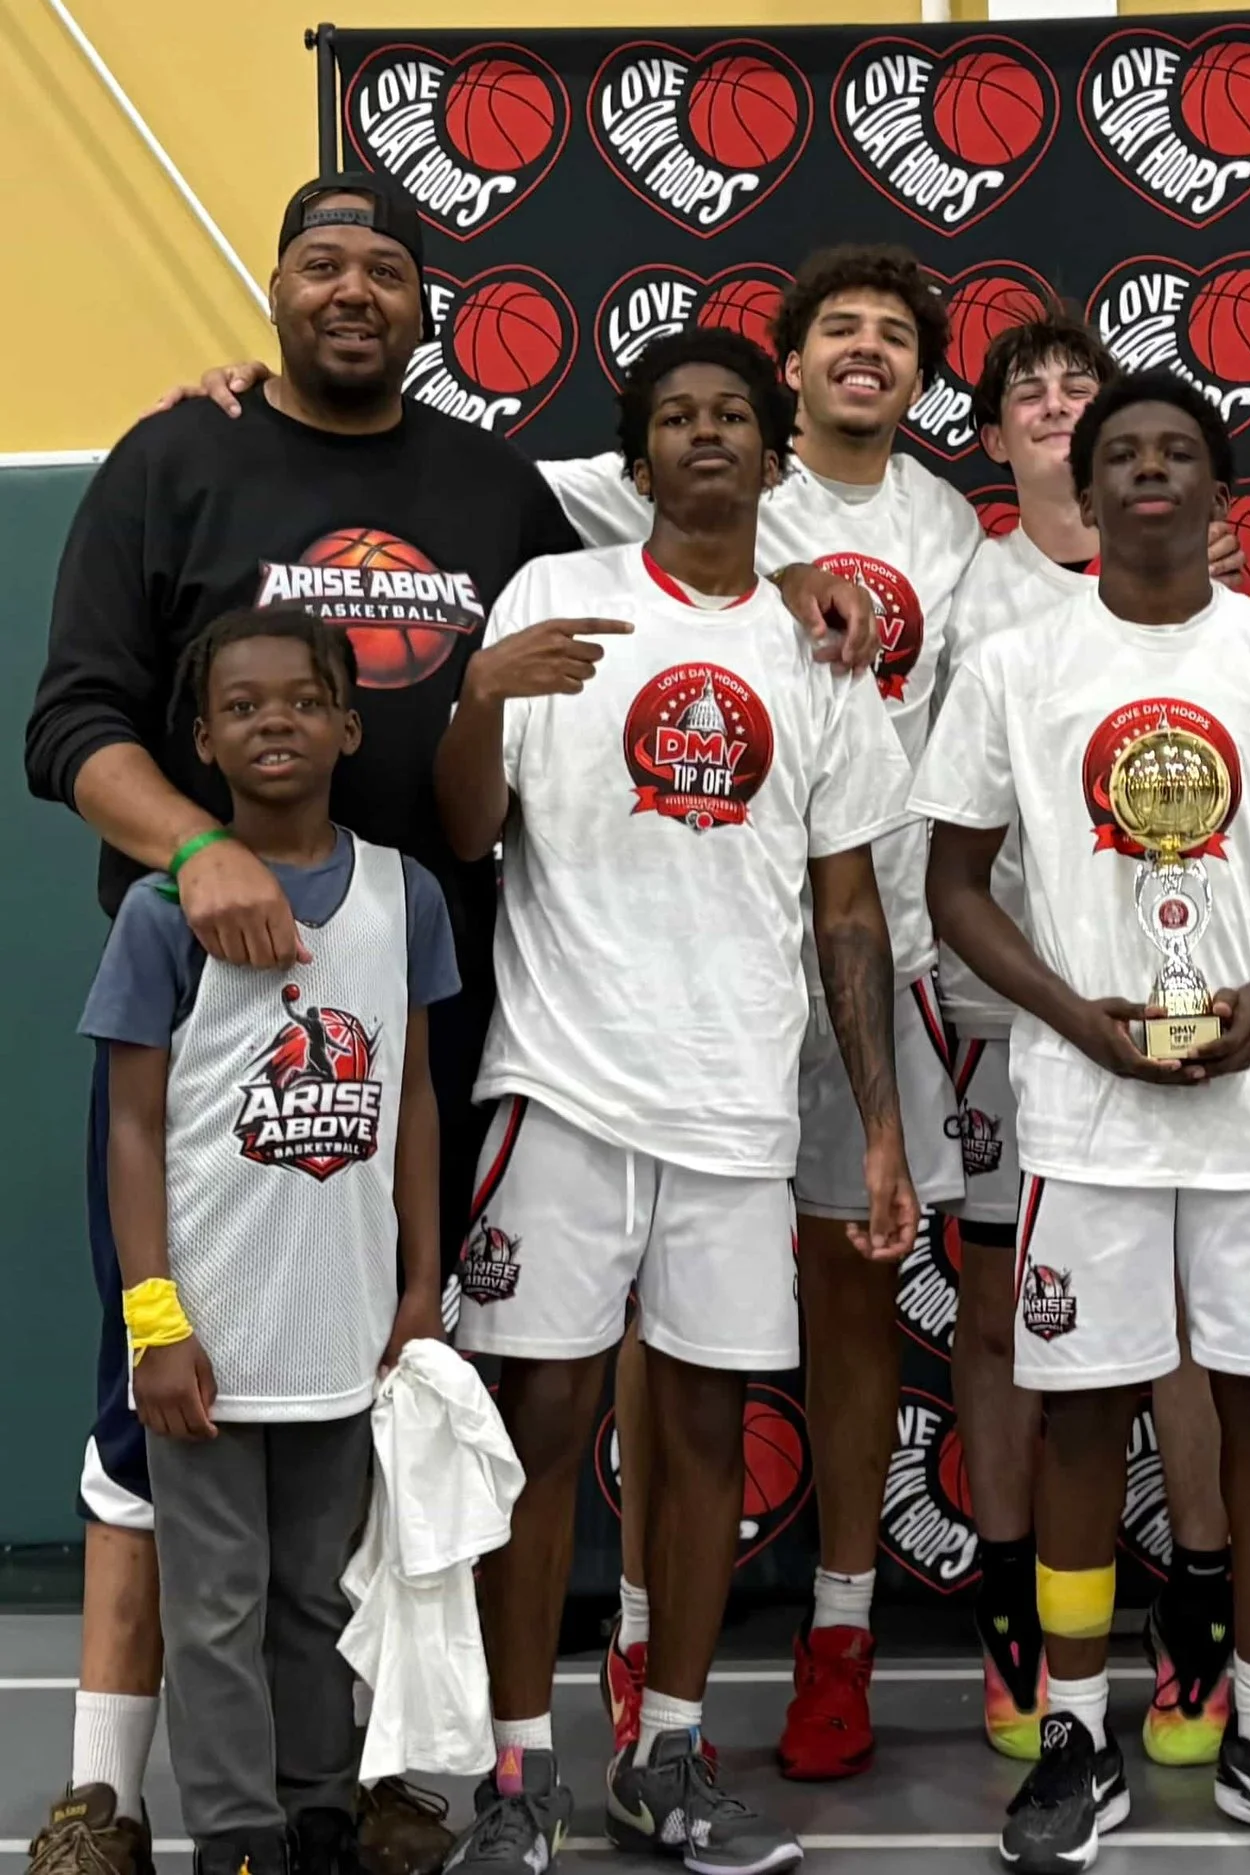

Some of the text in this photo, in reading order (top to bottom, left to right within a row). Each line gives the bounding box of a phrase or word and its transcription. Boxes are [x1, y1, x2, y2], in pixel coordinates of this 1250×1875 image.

[602, 59, 688, 131] LOVE
[1093, 47, 1180, 120] LOVE
[360, 62, 516, 227] LOVE DAY HOOPS
[609, 100, 679, 172] DAY
[846, 55, 1004, 222] LOVE DAY HOOPS
[1100, 89, 1171, 162] DAY
[645, 143, 759, 224] HOOPS
[609, 281, 698, 352] LOVE
[1099, 274, 1189, 345] LOVE
[258, 563, 485, 618] ARISE ABOVE
[657, 668, 750, 702] LOVE DAY HOOPS
[1111, 704, 1211, 730] LOVE DAY HOOPS
[655, 726, 748, 771] DMV
[673, 765, 733, 796] TIP OFF
[240, 1082, 380, 1126] ARISE
[255, 1116, 372, 1147] ABOVE
[896, 1263, 959, 1347] HOOP
[897, 1405, 942, 1446] VE
